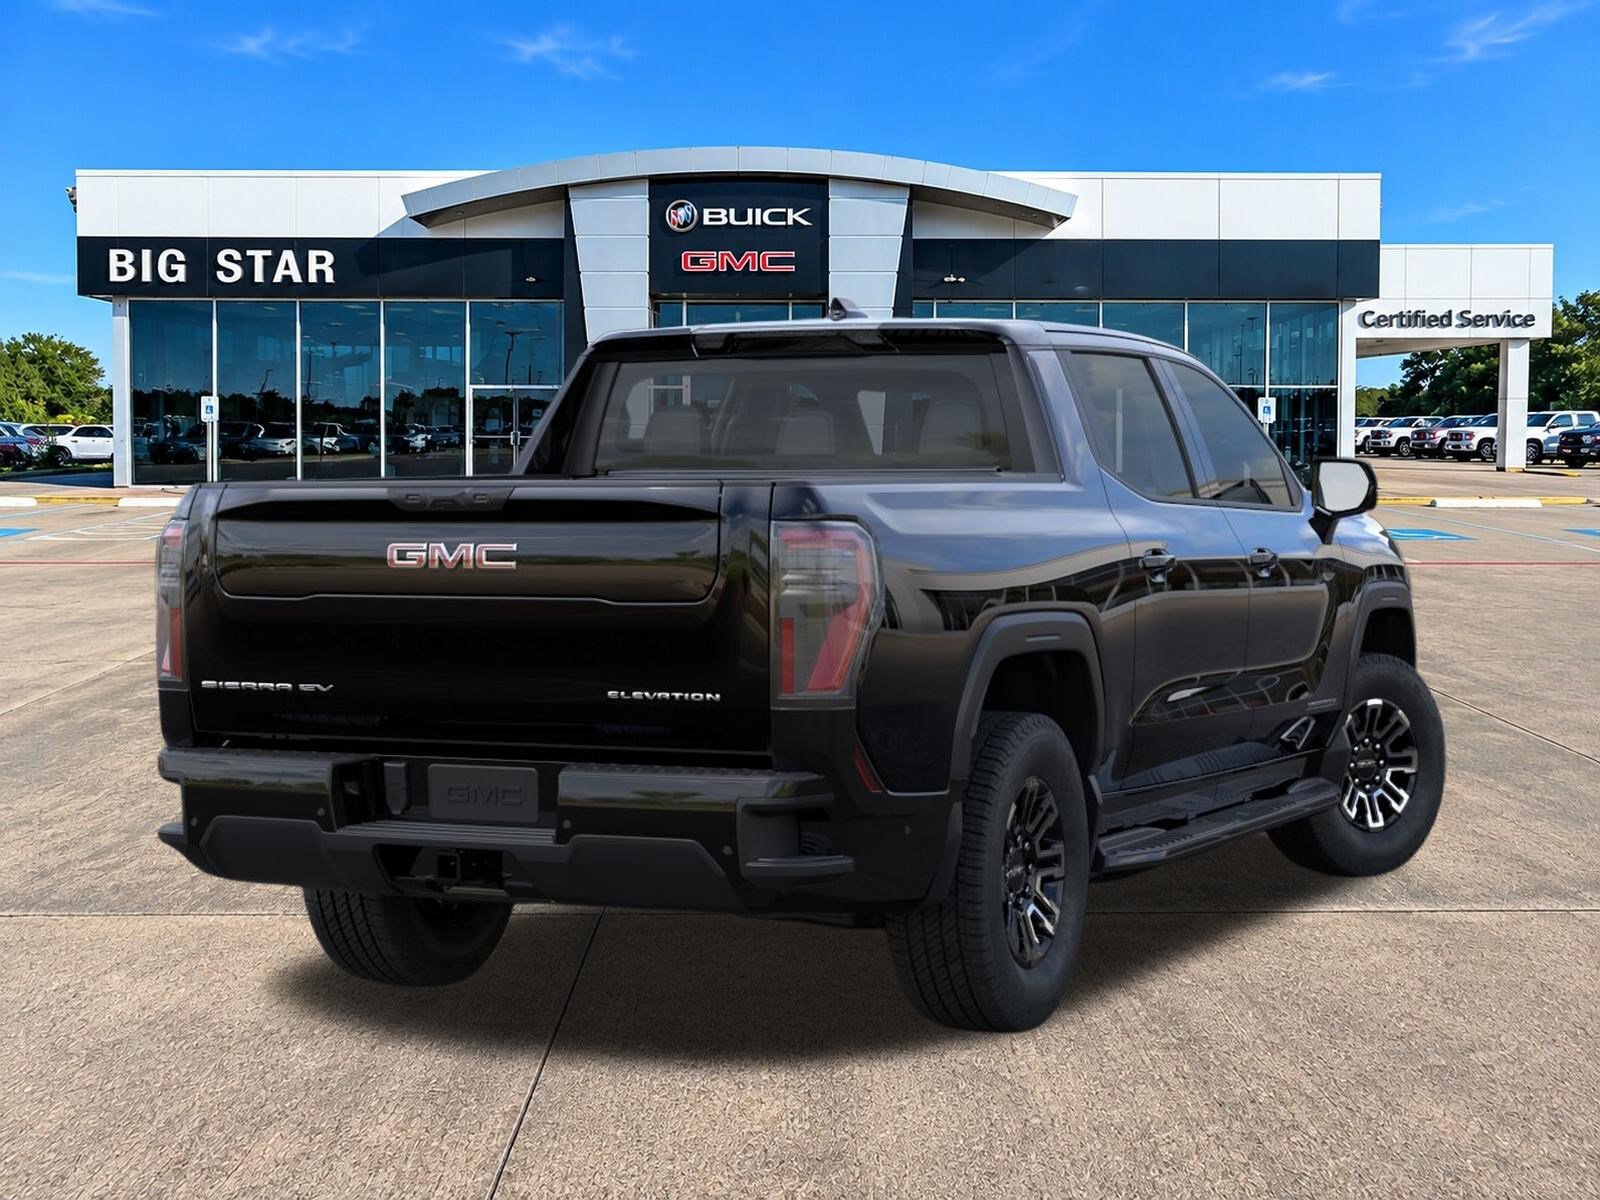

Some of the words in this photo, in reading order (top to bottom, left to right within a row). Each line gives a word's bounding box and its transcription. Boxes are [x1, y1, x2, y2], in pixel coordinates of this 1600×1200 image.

[702, 207, 813, 226] BUICK
[108, 248, 187, 283] BIG
[215, 248, 336, 284] STAR
[681, 250, 796, 272] GMC
[1360, 309, 1453, 329] Certified
[1455, 309, 1536, 329] Service
[387, 542, 517, 570] GMC
[201, 680, 293, 691] SIERRA
[298, 683, 334, 692] EV
[607, 690, 721, 702] ELEVATION
